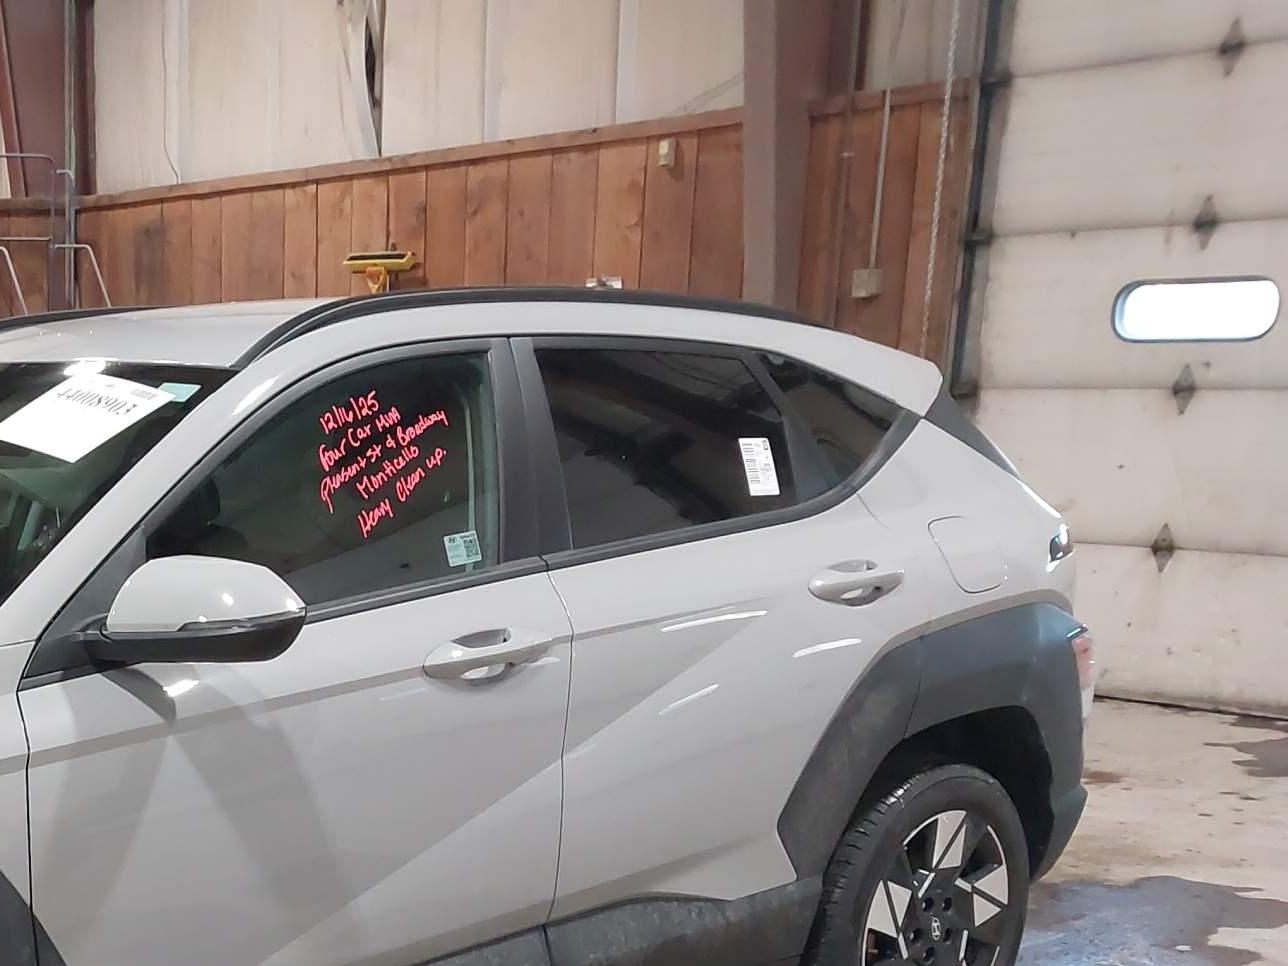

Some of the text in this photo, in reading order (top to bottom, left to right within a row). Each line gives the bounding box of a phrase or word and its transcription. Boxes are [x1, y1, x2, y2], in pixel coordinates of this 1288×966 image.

[320, 390, 379, 434] 12/16/25
[396, 410, 449, 446] Broadway
[348, 424, 372, 447] Car
[356, 446, 419, 499] Monticello
[395, 467, 425, 502] Clean
